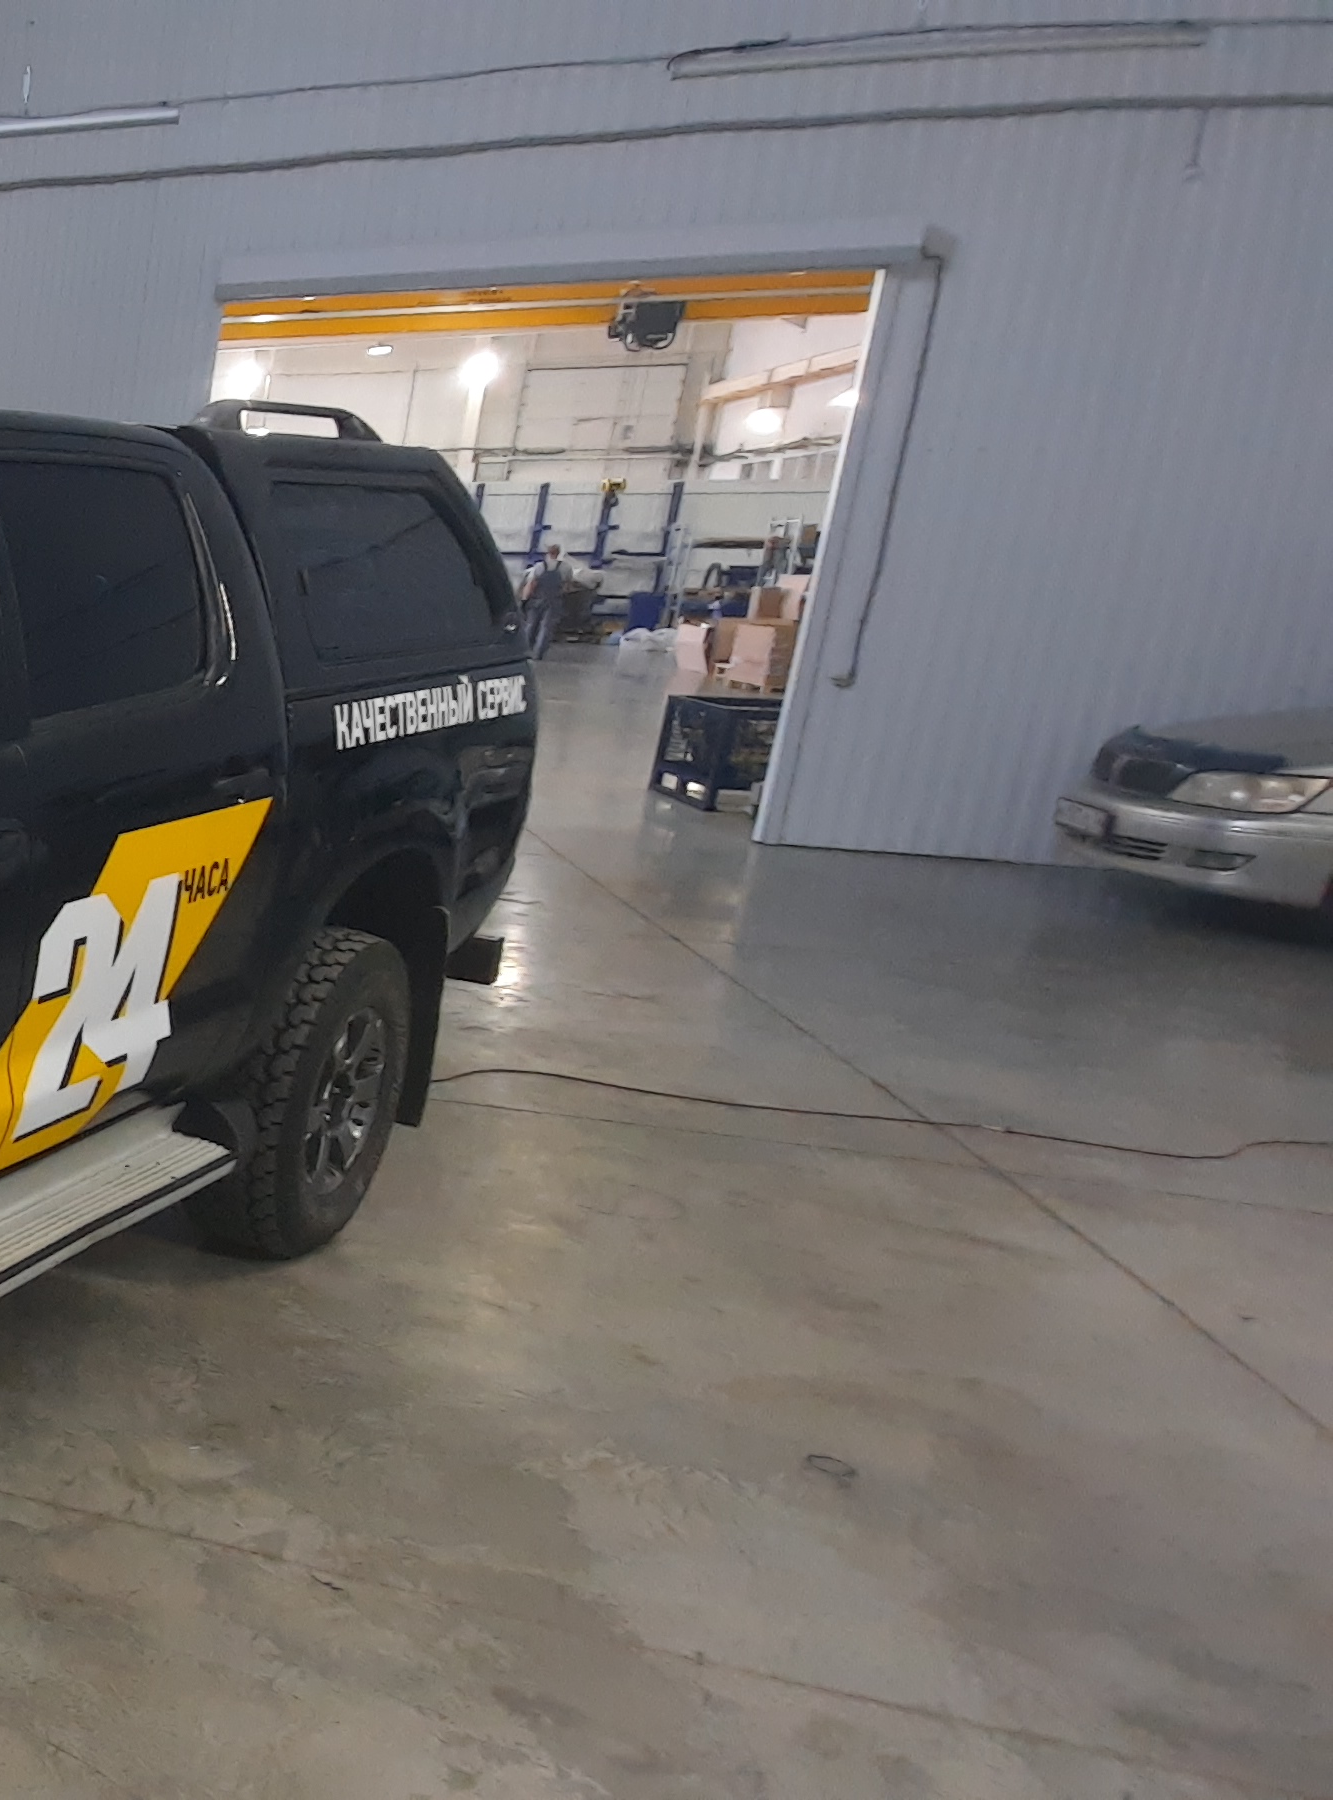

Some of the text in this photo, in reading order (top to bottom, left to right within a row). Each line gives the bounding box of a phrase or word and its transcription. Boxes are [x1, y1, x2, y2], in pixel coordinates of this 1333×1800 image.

[334, 674, 527, 751] КАЧЕСТВЕННЫЙ СЕРВИС
[11, 857, 230, 1143] 24 ЧАСА
